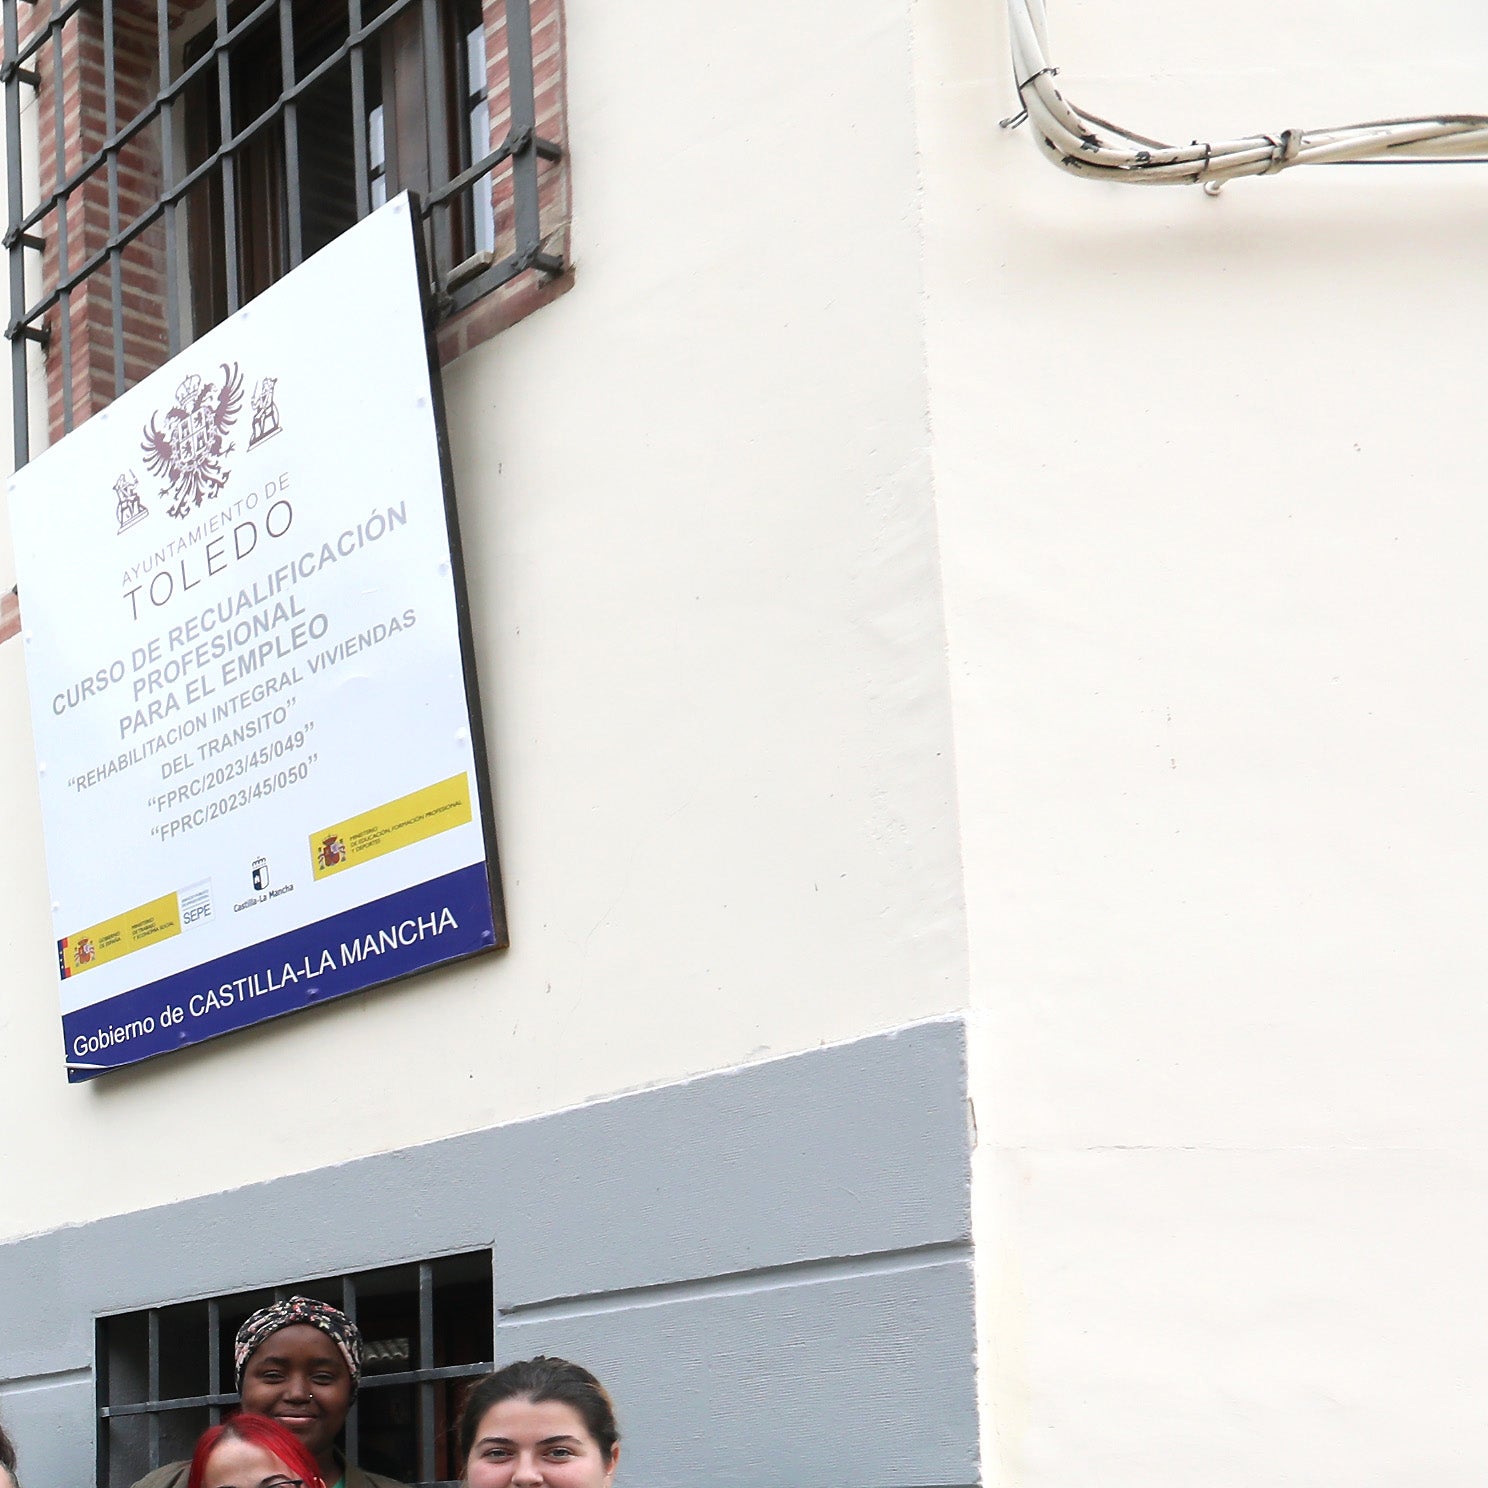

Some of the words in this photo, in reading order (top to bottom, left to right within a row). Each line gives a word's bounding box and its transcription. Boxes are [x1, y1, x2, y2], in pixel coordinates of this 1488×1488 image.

[122, 492, 258, 586] AYUNTAMIENTO
[264, 471, 289, 499] DE
[123, 499, 292, 620] TOLEDO
[52, 660, 124, 715] CURSO
[131, 637, 161, 672] DE
[168, 500, 406, 651] RECUALIFICACIÓN
[133, 594, 305, 702] PROFESIONAL
[67, 712, 206, 792] “REHABILITACION
[212, 666, 303, 723] INTEGRAL
[306, 608, 415, 674] VIVIENDAS
[119, 692, 180, 739] PARA
[185, 674, 215, 705] EL
[221, 613, 328, 686] EMPLEO
[147, 721, 313, 812] “FPRC/2023/45/049”
[161, 753, 194, 779] DEL
[197, 696, 295, 760] TRANSITO”
[150, 753, 317, 841] “FPRC/2023/45/050”
[183, 904, 212, 924] SEPE
[233, 893, 268, 912] Castilla-La
[268, 883, 294, 899] Mancha
[73, 1016, 154, 1056] Gobierno
[160, 1004, 183, 1027] de
[189, 949, 336, 1016] CASTILLA-LA
[340, 907, 458, 966] MANCHA
